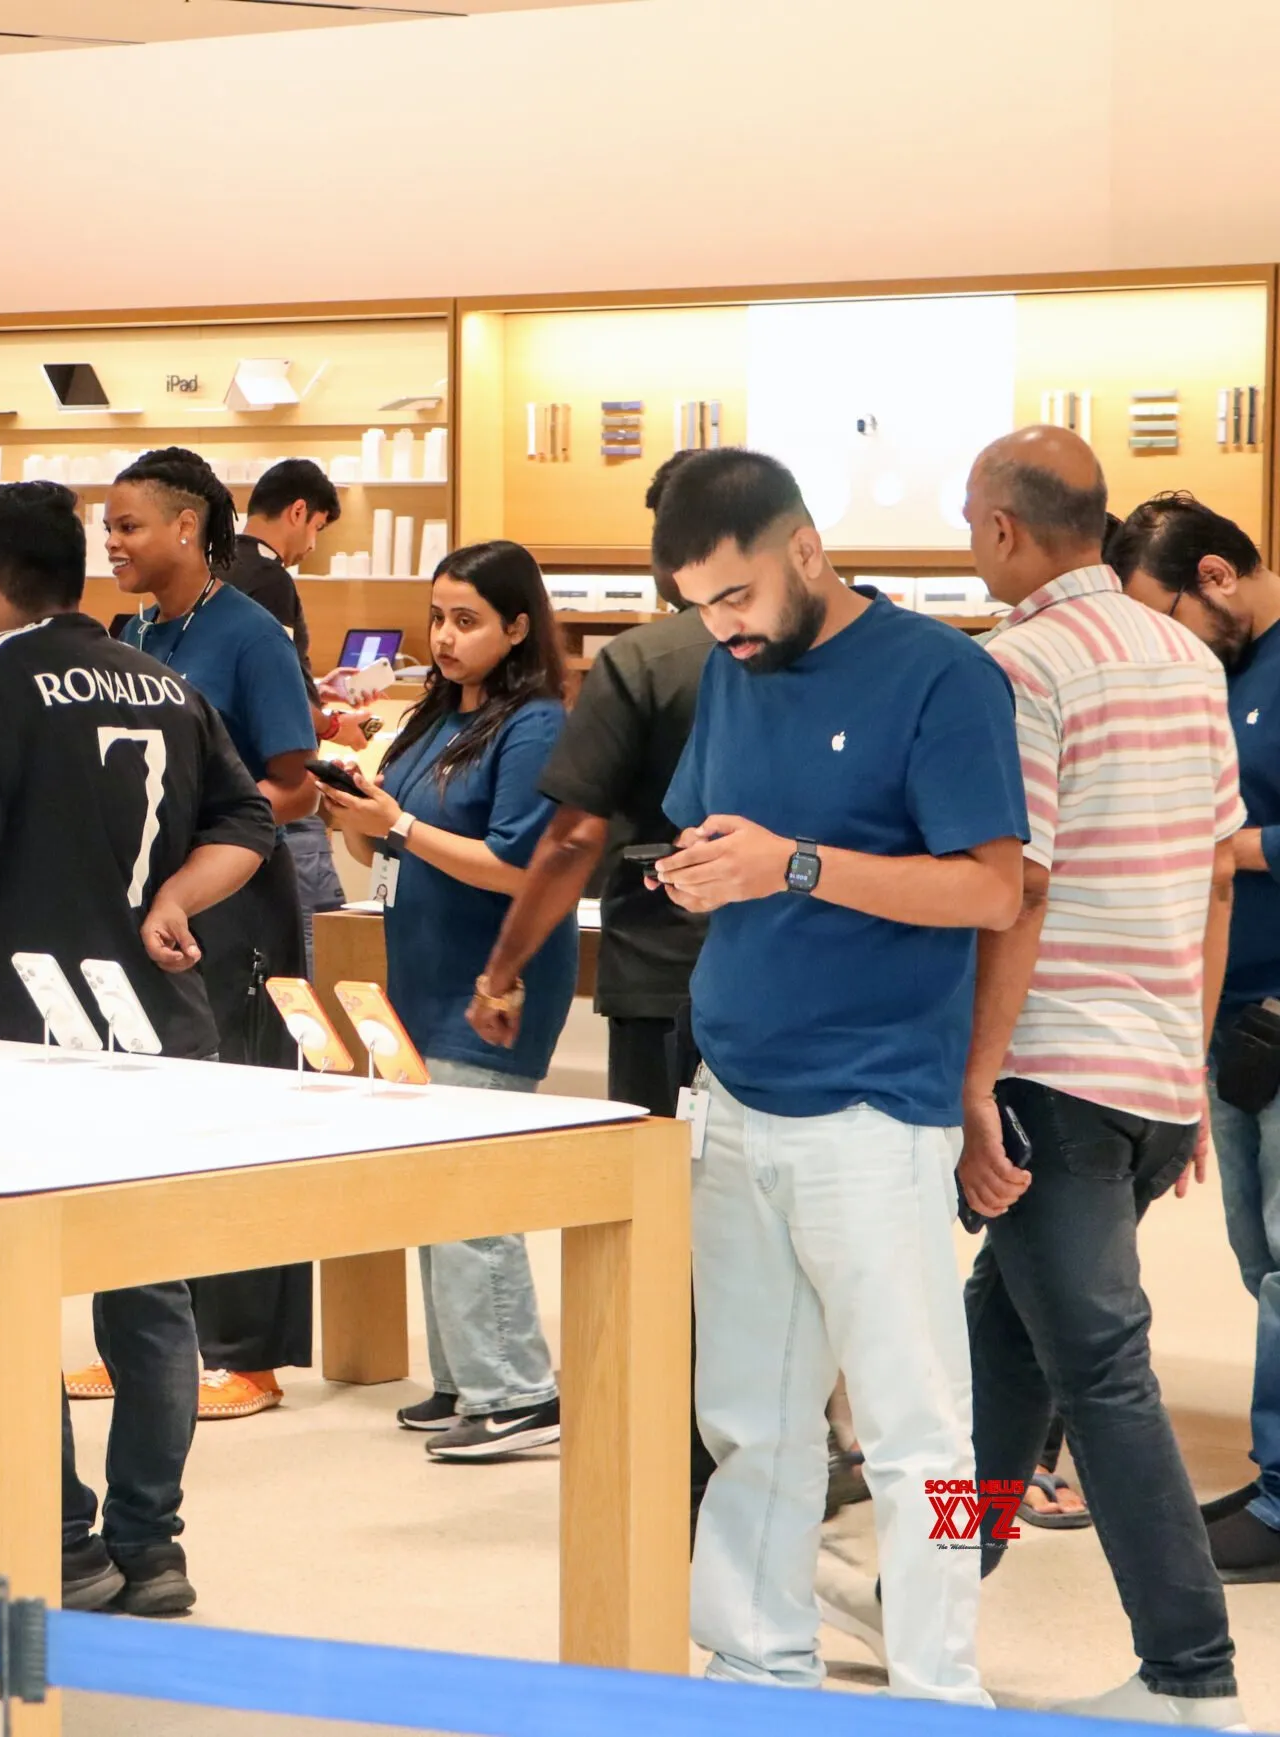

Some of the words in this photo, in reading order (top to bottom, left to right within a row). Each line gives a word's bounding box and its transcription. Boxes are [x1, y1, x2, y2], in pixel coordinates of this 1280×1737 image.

[166, 374, 198, 392] iPad
[33, 667, 185, 706] RONALDO
[97, 726, 167, 909] 7
